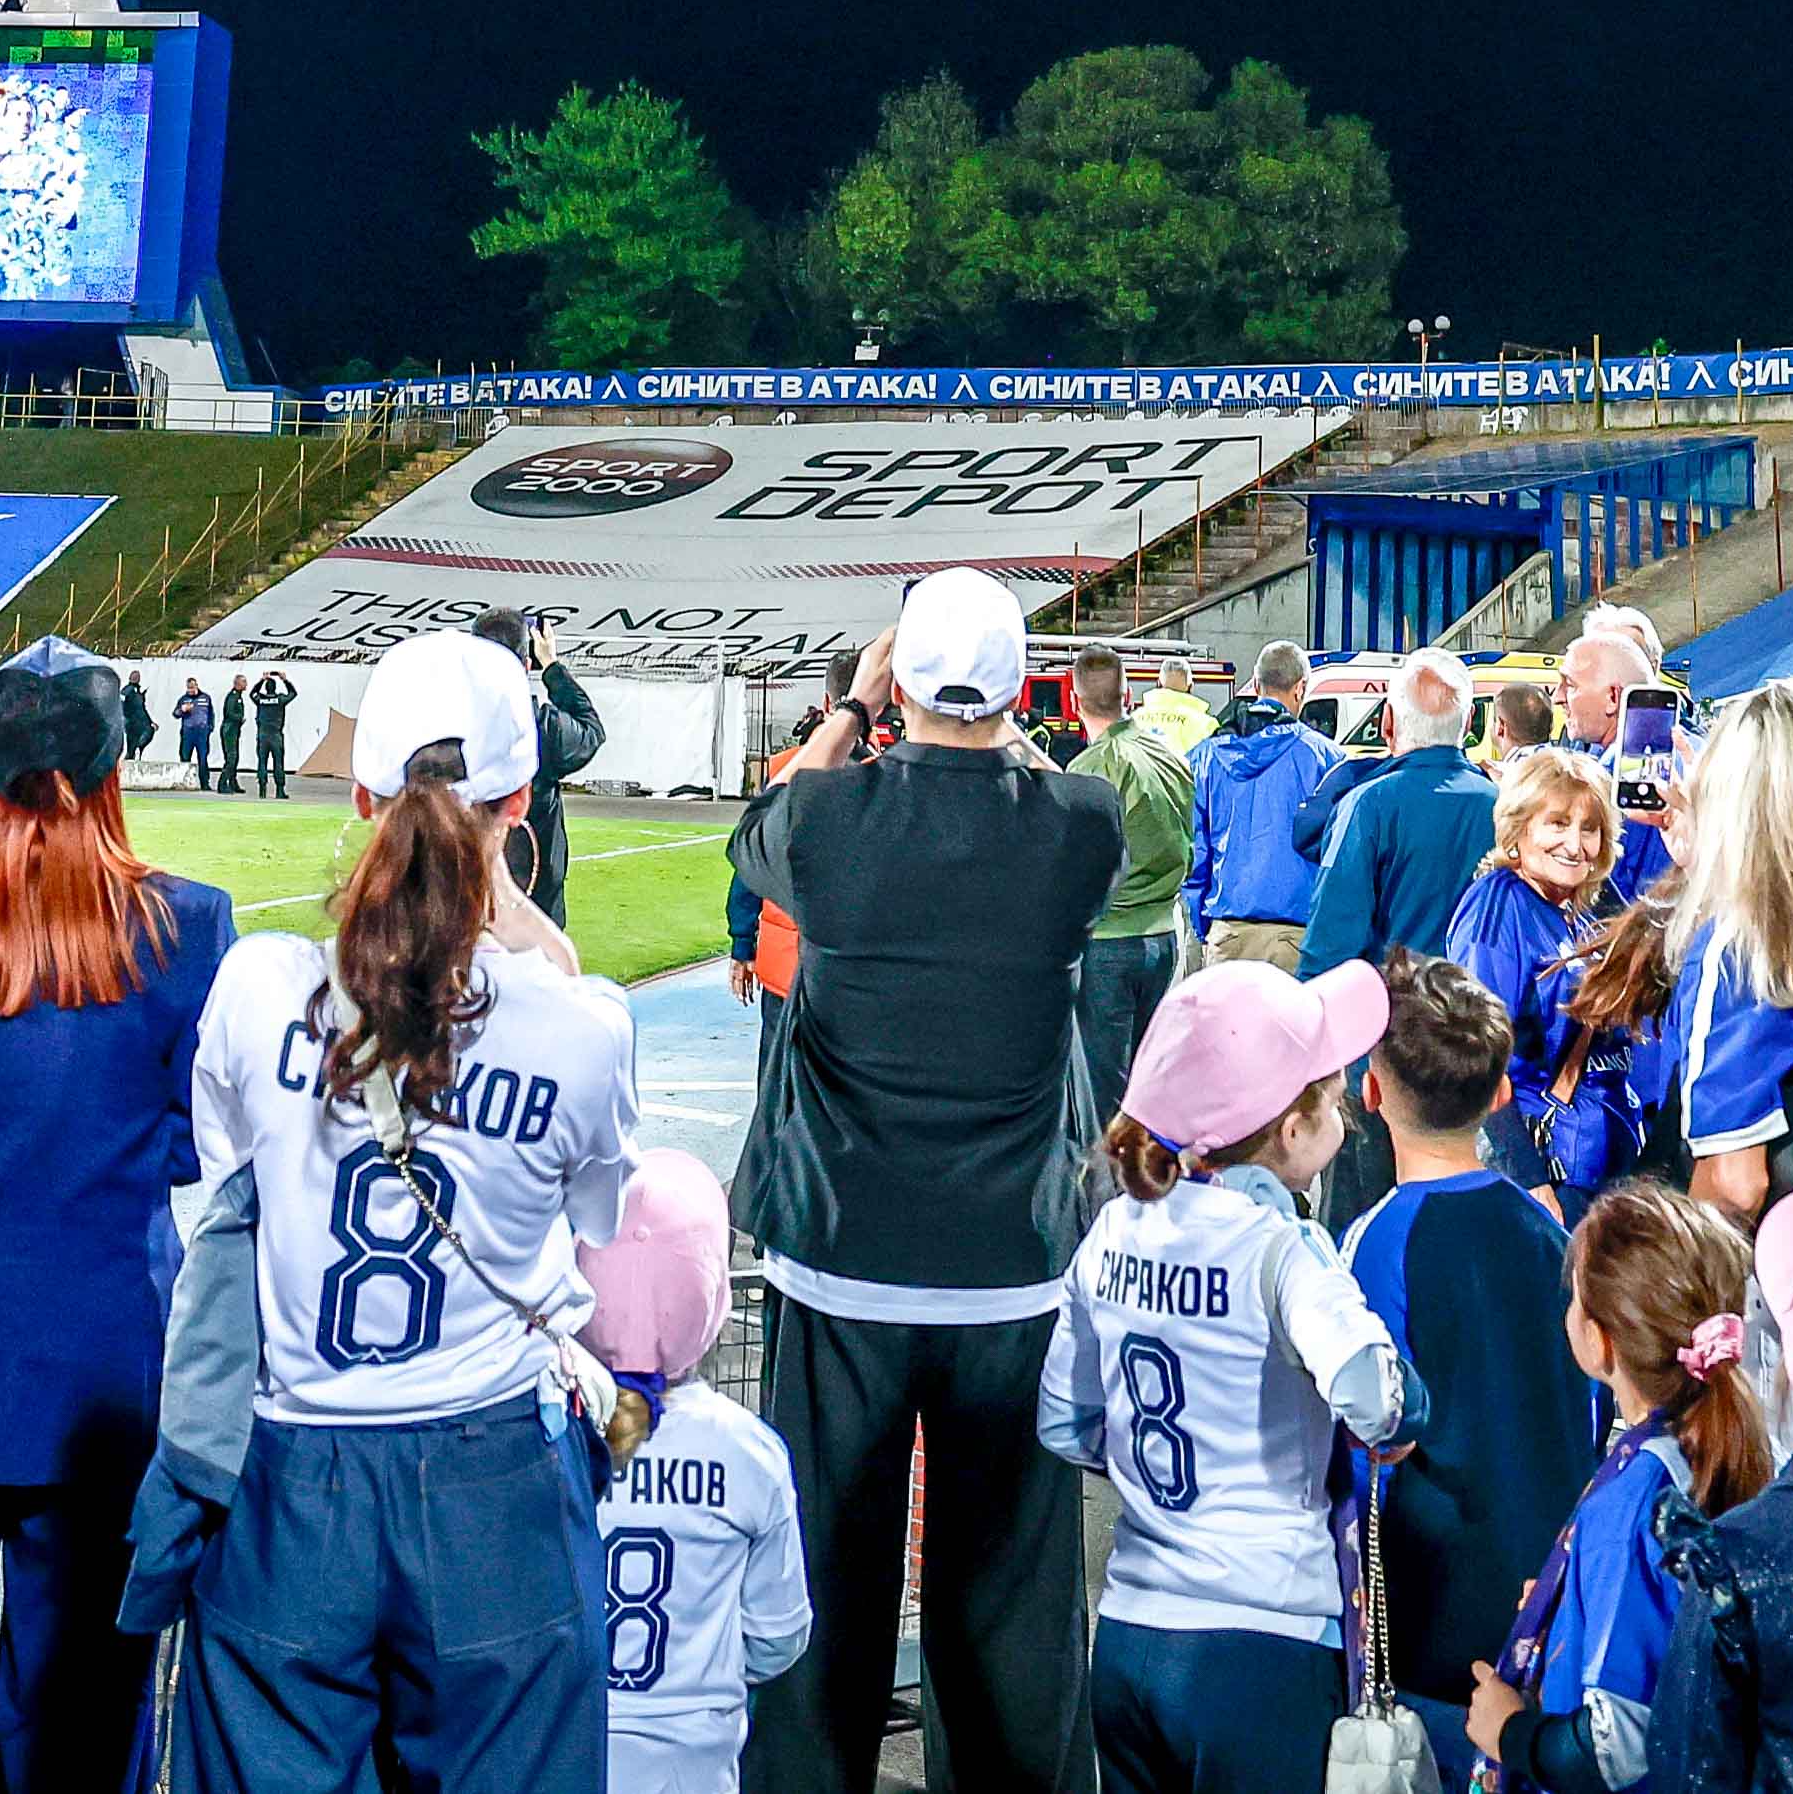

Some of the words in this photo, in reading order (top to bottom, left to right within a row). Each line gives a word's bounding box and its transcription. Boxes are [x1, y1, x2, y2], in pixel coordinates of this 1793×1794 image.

[475, 375, 593, 403] АТАКА!
[638, 374, 776, 399] СИНИТЕ
[808, 373, 938, 399] АТАКА!
[989, 376, 1132, 400] СИНИТЕ
[1166, 371, 1301, 399] АТАКА!
[1353, 370, 1499, 397] СИНИТЕ
[1533, 363, 1672, 395] АТАКА!
[520, 457, 717, 478] SPORT
[780, 435, 1262, 482] SPORT
[505, 474, 665, 497] 2000
[715, 475, 1203, 519] DEPOT
[318, 589, 491, 623] THIS
[586, 607, 783, 631] NOT
[260, 617, 476, 648] JUS
[315, 1139, 457, 1371] 8
[1096, 1249, 1230, 1318] СИРАКОВ
[1119, 1332, 1200, 1512] 8
[605, 1526, 676, 1692] 8
